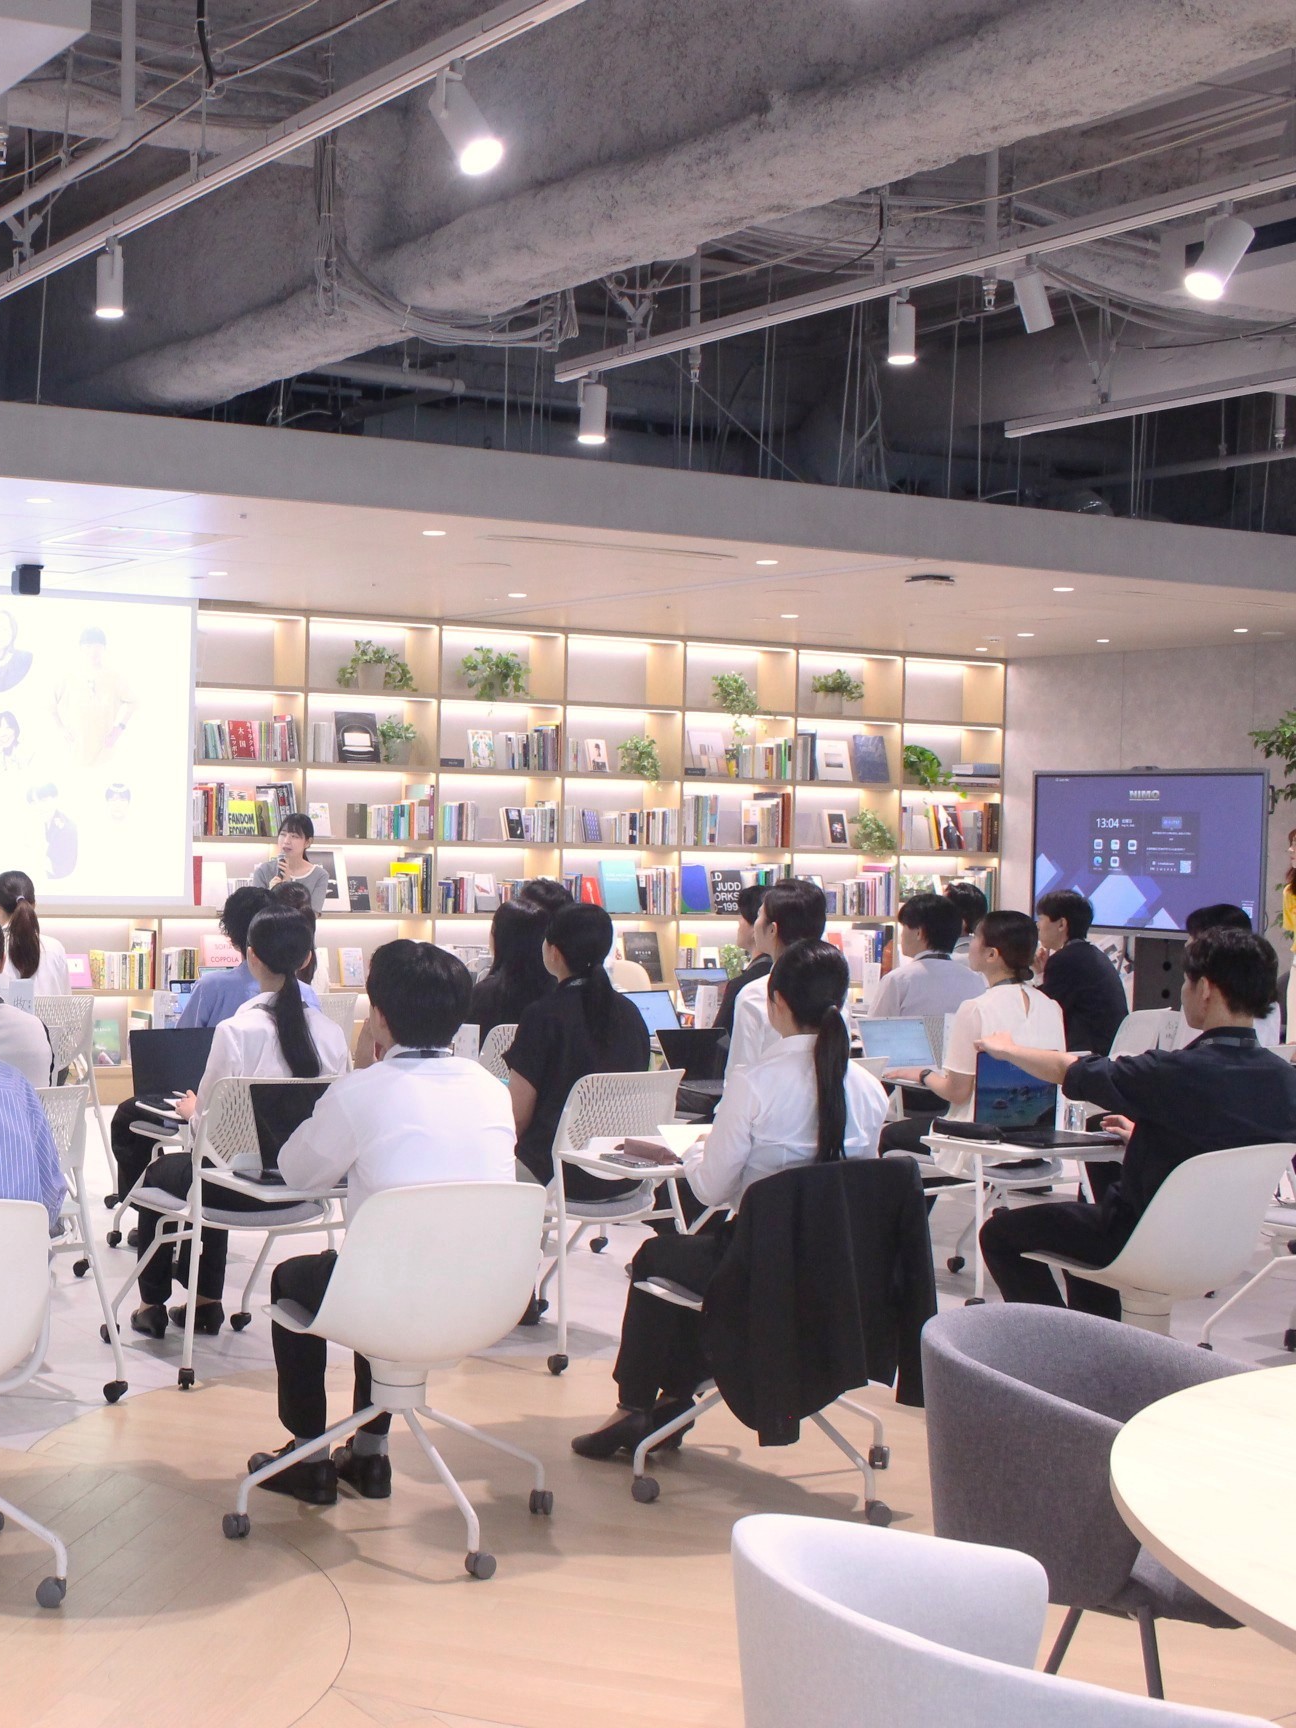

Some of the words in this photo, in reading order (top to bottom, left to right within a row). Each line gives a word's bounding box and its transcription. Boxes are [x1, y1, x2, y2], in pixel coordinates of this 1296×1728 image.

[245, 721, 256, 758] キャラクター
[1129, 790, 1160, 799] NIMO
[228, 813, 254, 825] FANDOM
[1096, 818, 1119, 828] 13:04
[716, 882, 741, 892] JUDD
